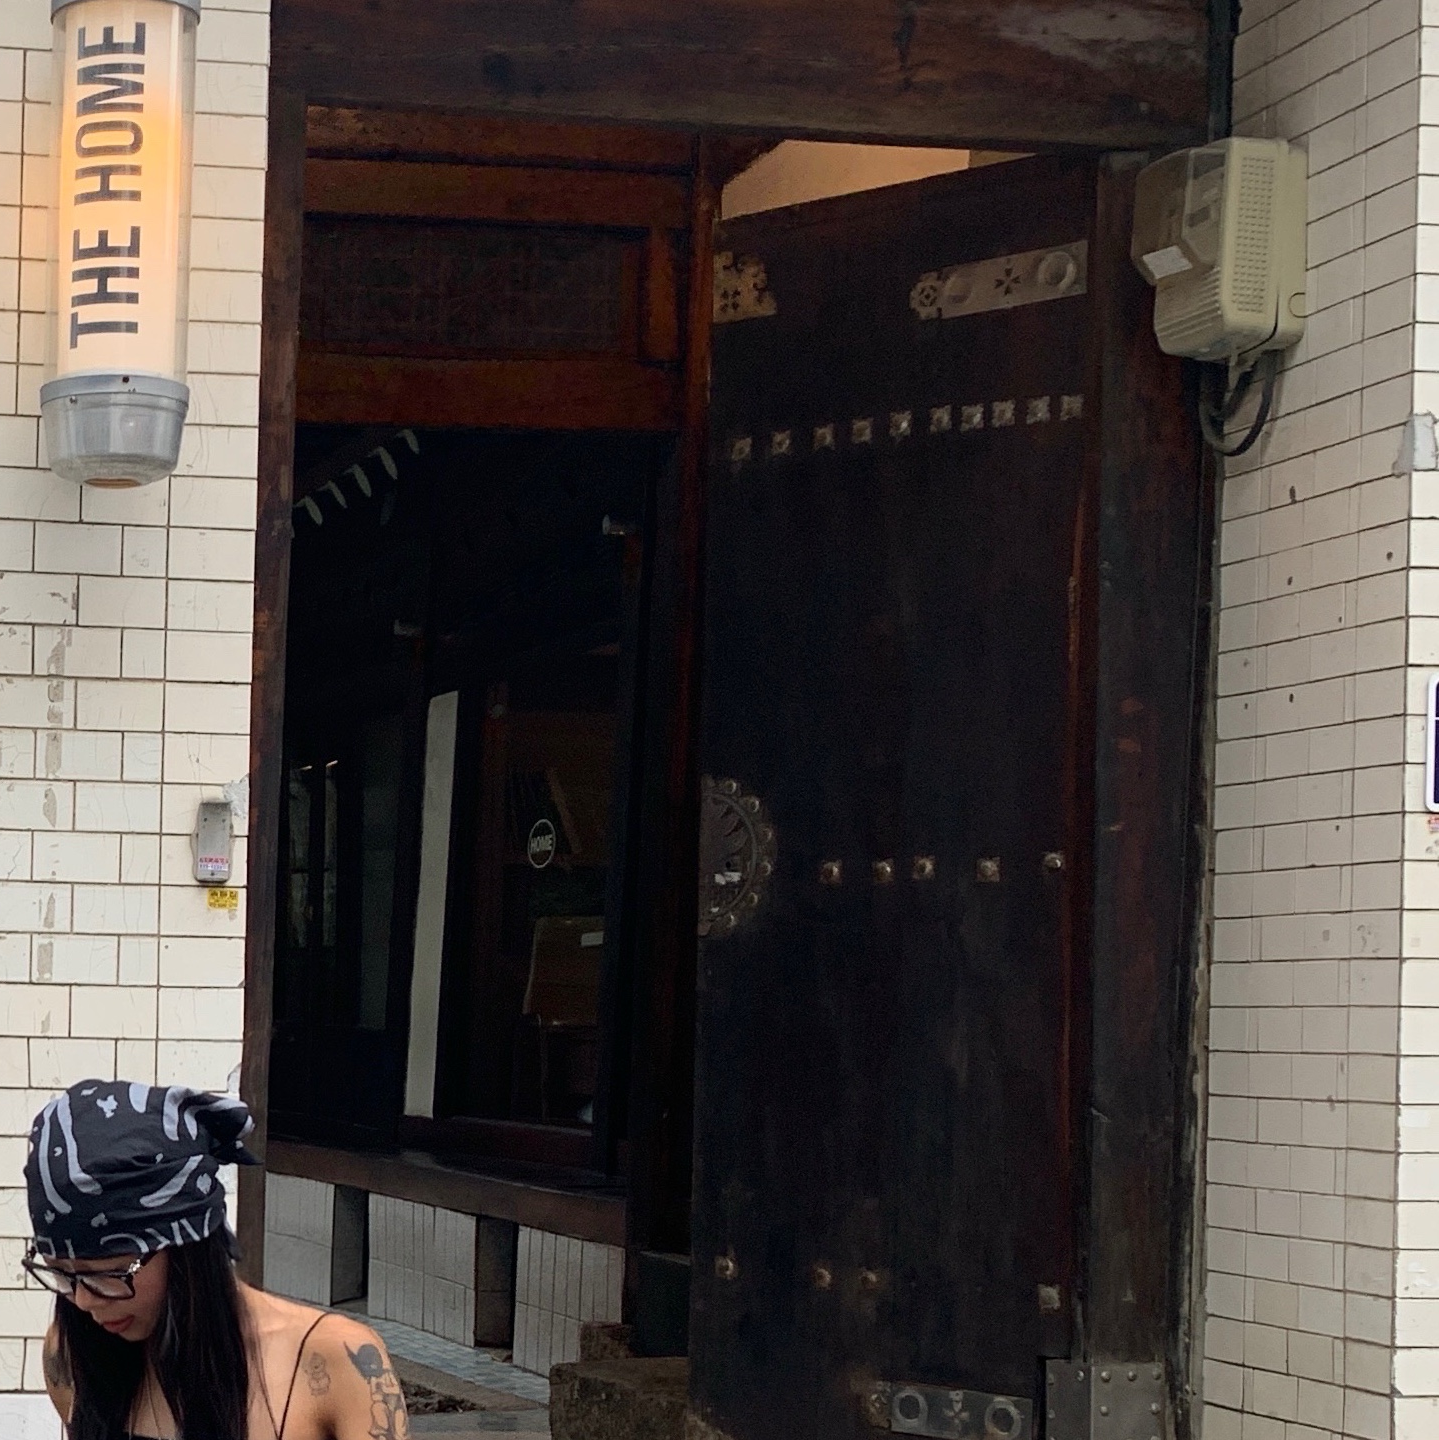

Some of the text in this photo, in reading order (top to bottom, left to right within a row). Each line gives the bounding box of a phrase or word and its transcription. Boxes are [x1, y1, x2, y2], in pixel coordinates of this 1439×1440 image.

[70, 22, 147, 350] THE HOME
[530, 833, 553, 855] HOME
